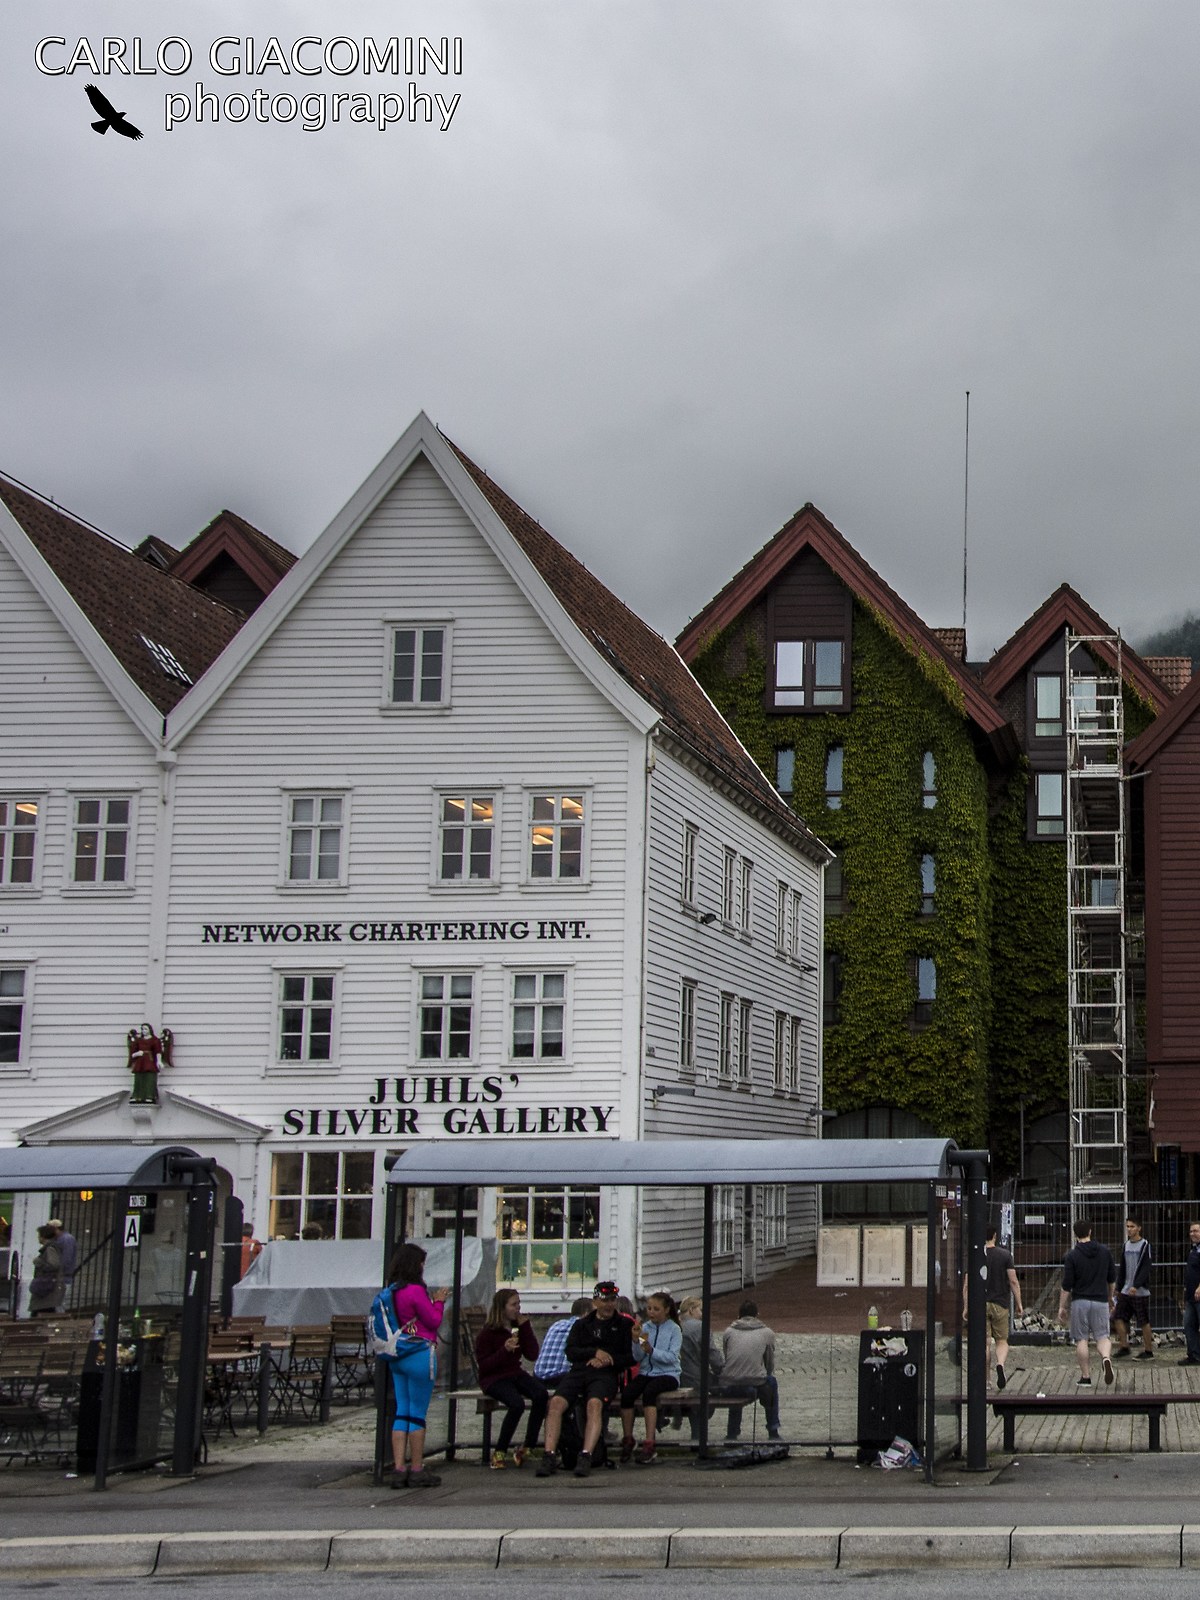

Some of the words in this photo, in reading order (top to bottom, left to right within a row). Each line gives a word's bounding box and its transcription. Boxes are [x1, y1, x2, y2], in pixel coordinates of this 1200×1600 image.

[202, 923, 342, 942] NETWORK
[349, 921, 530, 942] CHARTERING
[537, 920, 592, 940] INT.
[282, 1108, 420, 1136] SILVER
[443, 1105, 614, 1135] GALLERY
[126, 1218, 137, 1243] A
